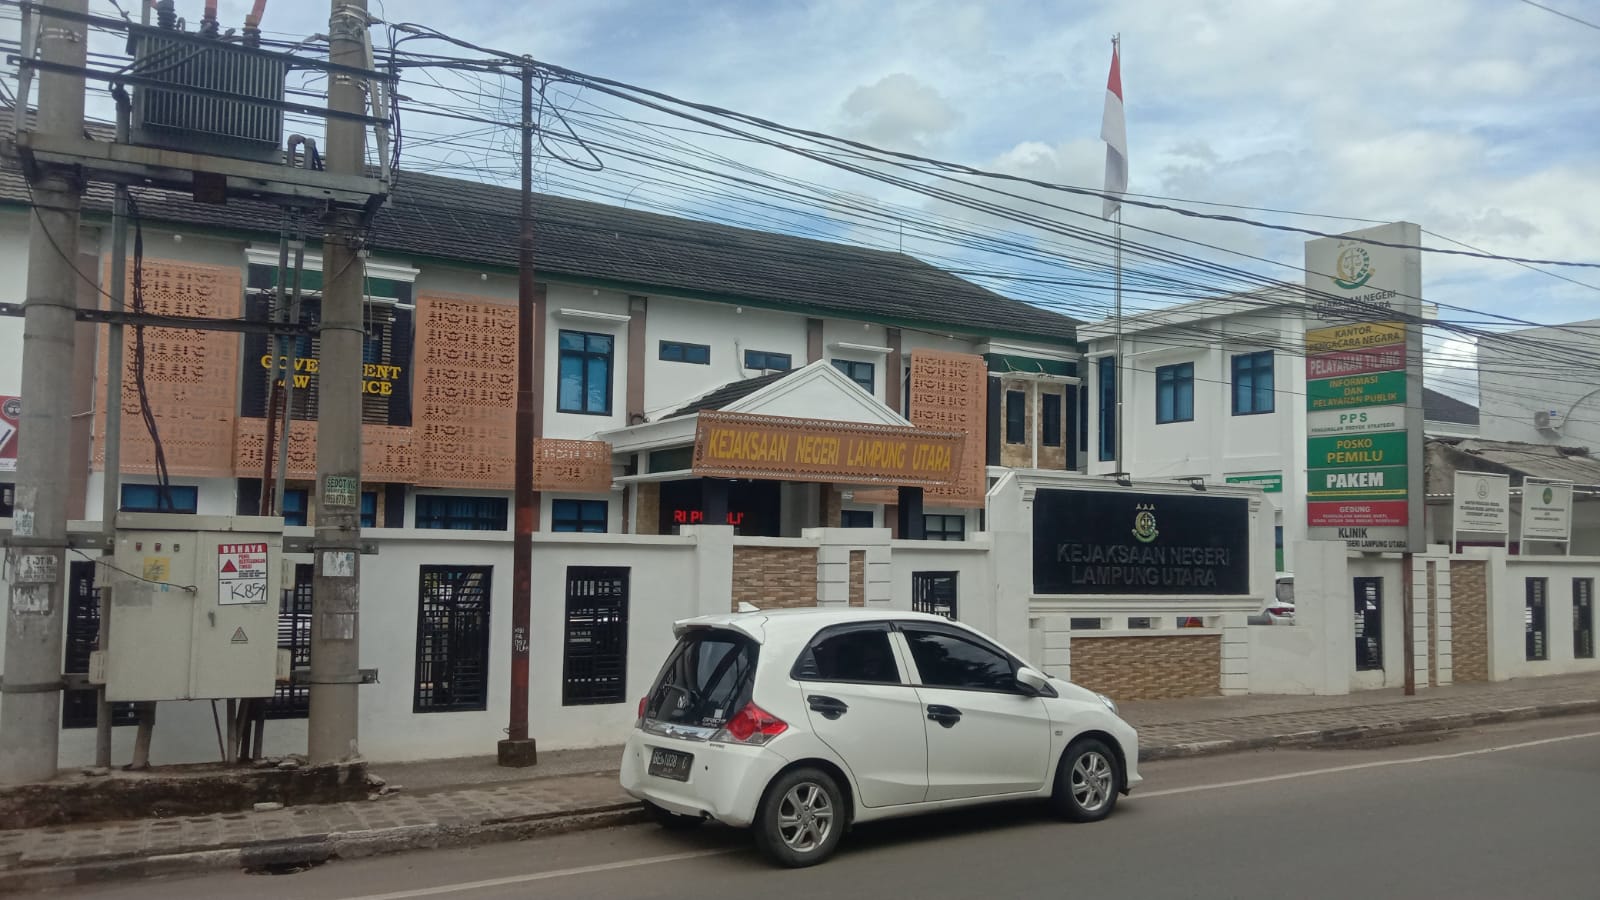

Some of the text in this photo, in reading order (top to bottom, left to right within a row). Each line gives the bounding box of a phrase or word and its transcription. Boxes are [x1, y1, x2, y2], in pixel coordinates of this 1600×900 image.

[1335, 326, 1371, 337] KANTOR
[1309, 333, 1399, 350] PENGACARA NEGARA
[1329, 376, 1378, 388] INFORMASI
[1344, 386, 1363, 395] DAN
[1364, 392, 1397, 401] PUBLIK
[1340, 412, 1368, 424] PPS
[1337, 438, 1373, 449] POSKO
[708, 429, 951, 472] KEJAKSAAN NEGERI LAMPUNG UTARA
[1327, 450, 1383, 464] PEMILU
[1326, 472, 1384, 488] PAKEM
[1338, 527, 1368, 538] KLINIK
[223, 544, 263, 553] BAHAYA
[1361, 540, 1388, 548] LAMPUNG
[1389, 540, 1408, 548] UTARA
[1057, 543, 1230, 566] KEJAKSAAN NEGERI
[1071, 565, 1216, 586] LAMPUNG UTARA
